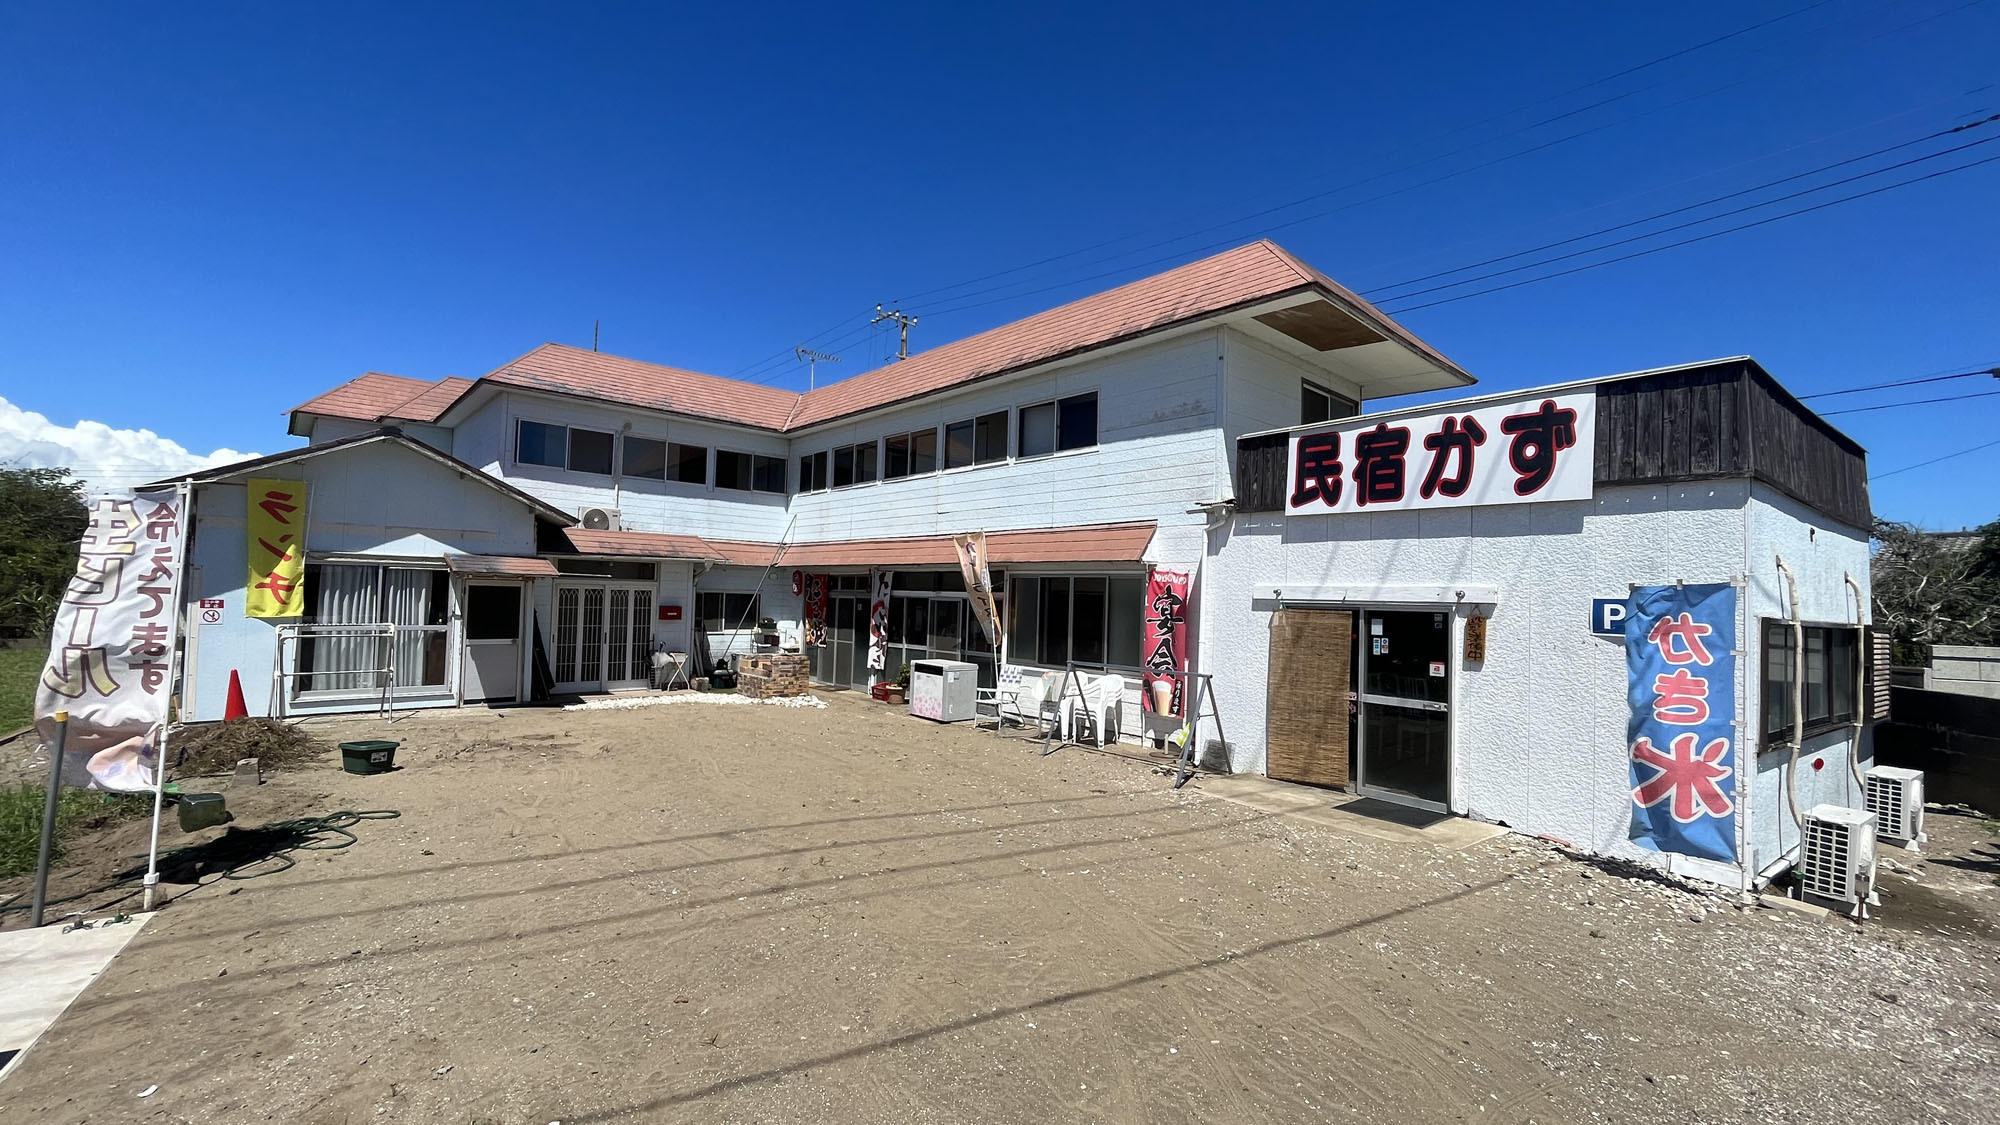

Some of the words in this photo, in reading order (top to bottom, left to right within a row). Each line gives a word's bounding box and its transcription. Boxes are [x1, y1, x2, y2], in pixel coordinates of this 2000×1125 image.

[1290, 400, 1577, 508] 民宿かず
[1146, 583, 1184, 680] 宴会
[1603, 603, 1627, 629] P
